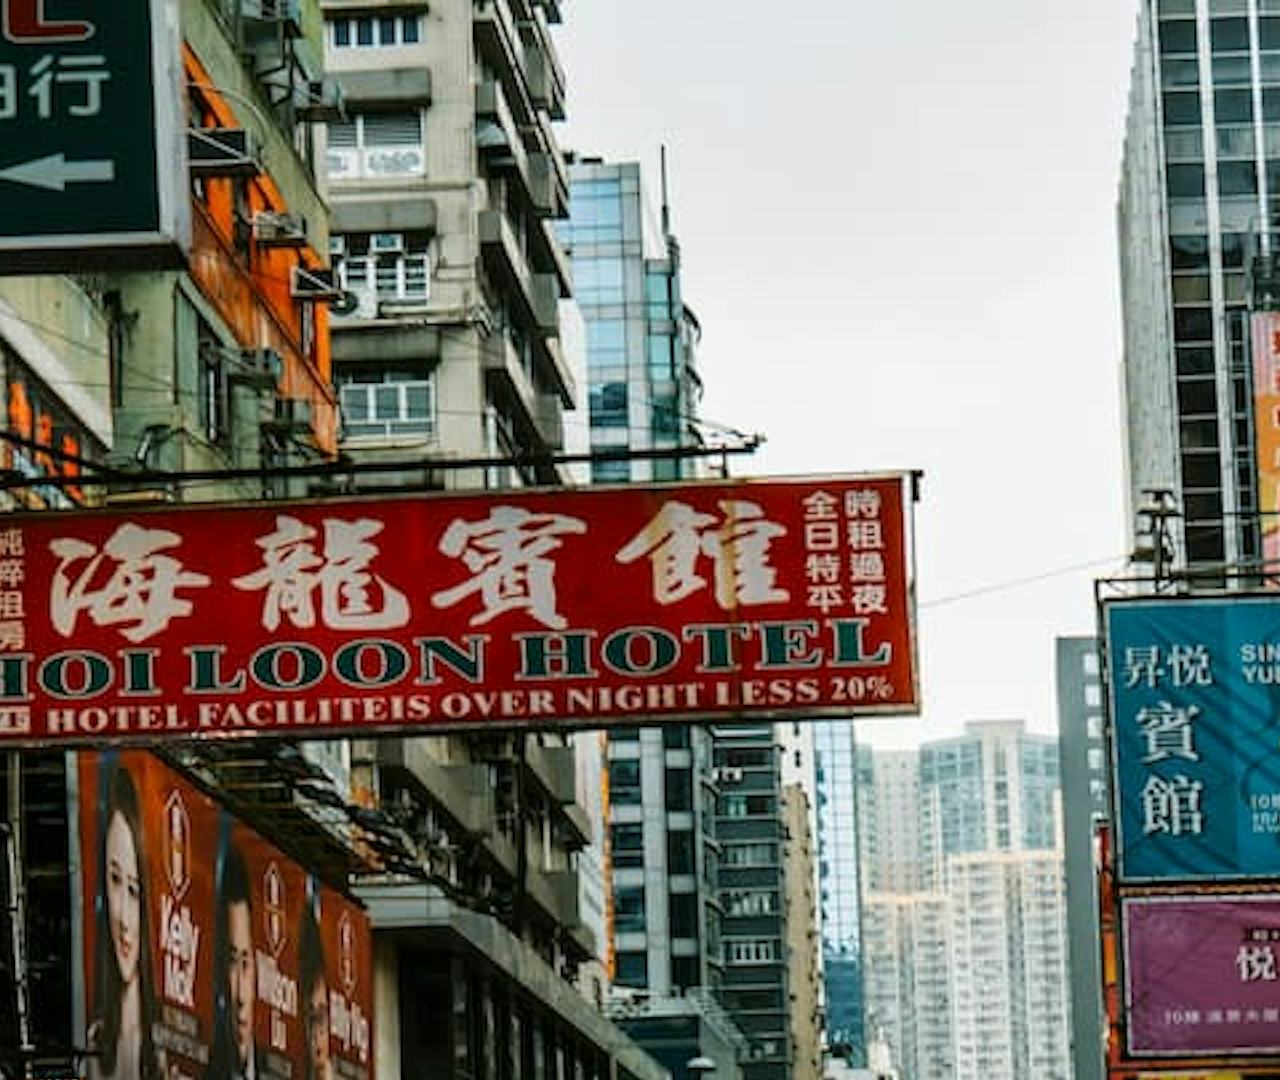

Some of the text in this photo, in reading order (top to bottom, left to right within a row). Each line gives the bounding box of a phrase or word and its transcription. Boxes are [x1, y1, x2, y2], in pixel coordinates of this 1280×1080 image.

[48, 500, 792, 643] 海龍賓館
[47, 704, 189, 734] HOTEL
[199, 694, 430, 729] FACILITEIS
[440, 689, 556, 719] OVER
[567, 684, 705, 714] NIGHT
[716, 678, 820, 707] LESS
[830, 675, 894, 700] 20%
[183, 634, 491, 695] LOON
[512, 617, 893, 682] HOTEL
[1134, 701, 1204, 838] 賓館
